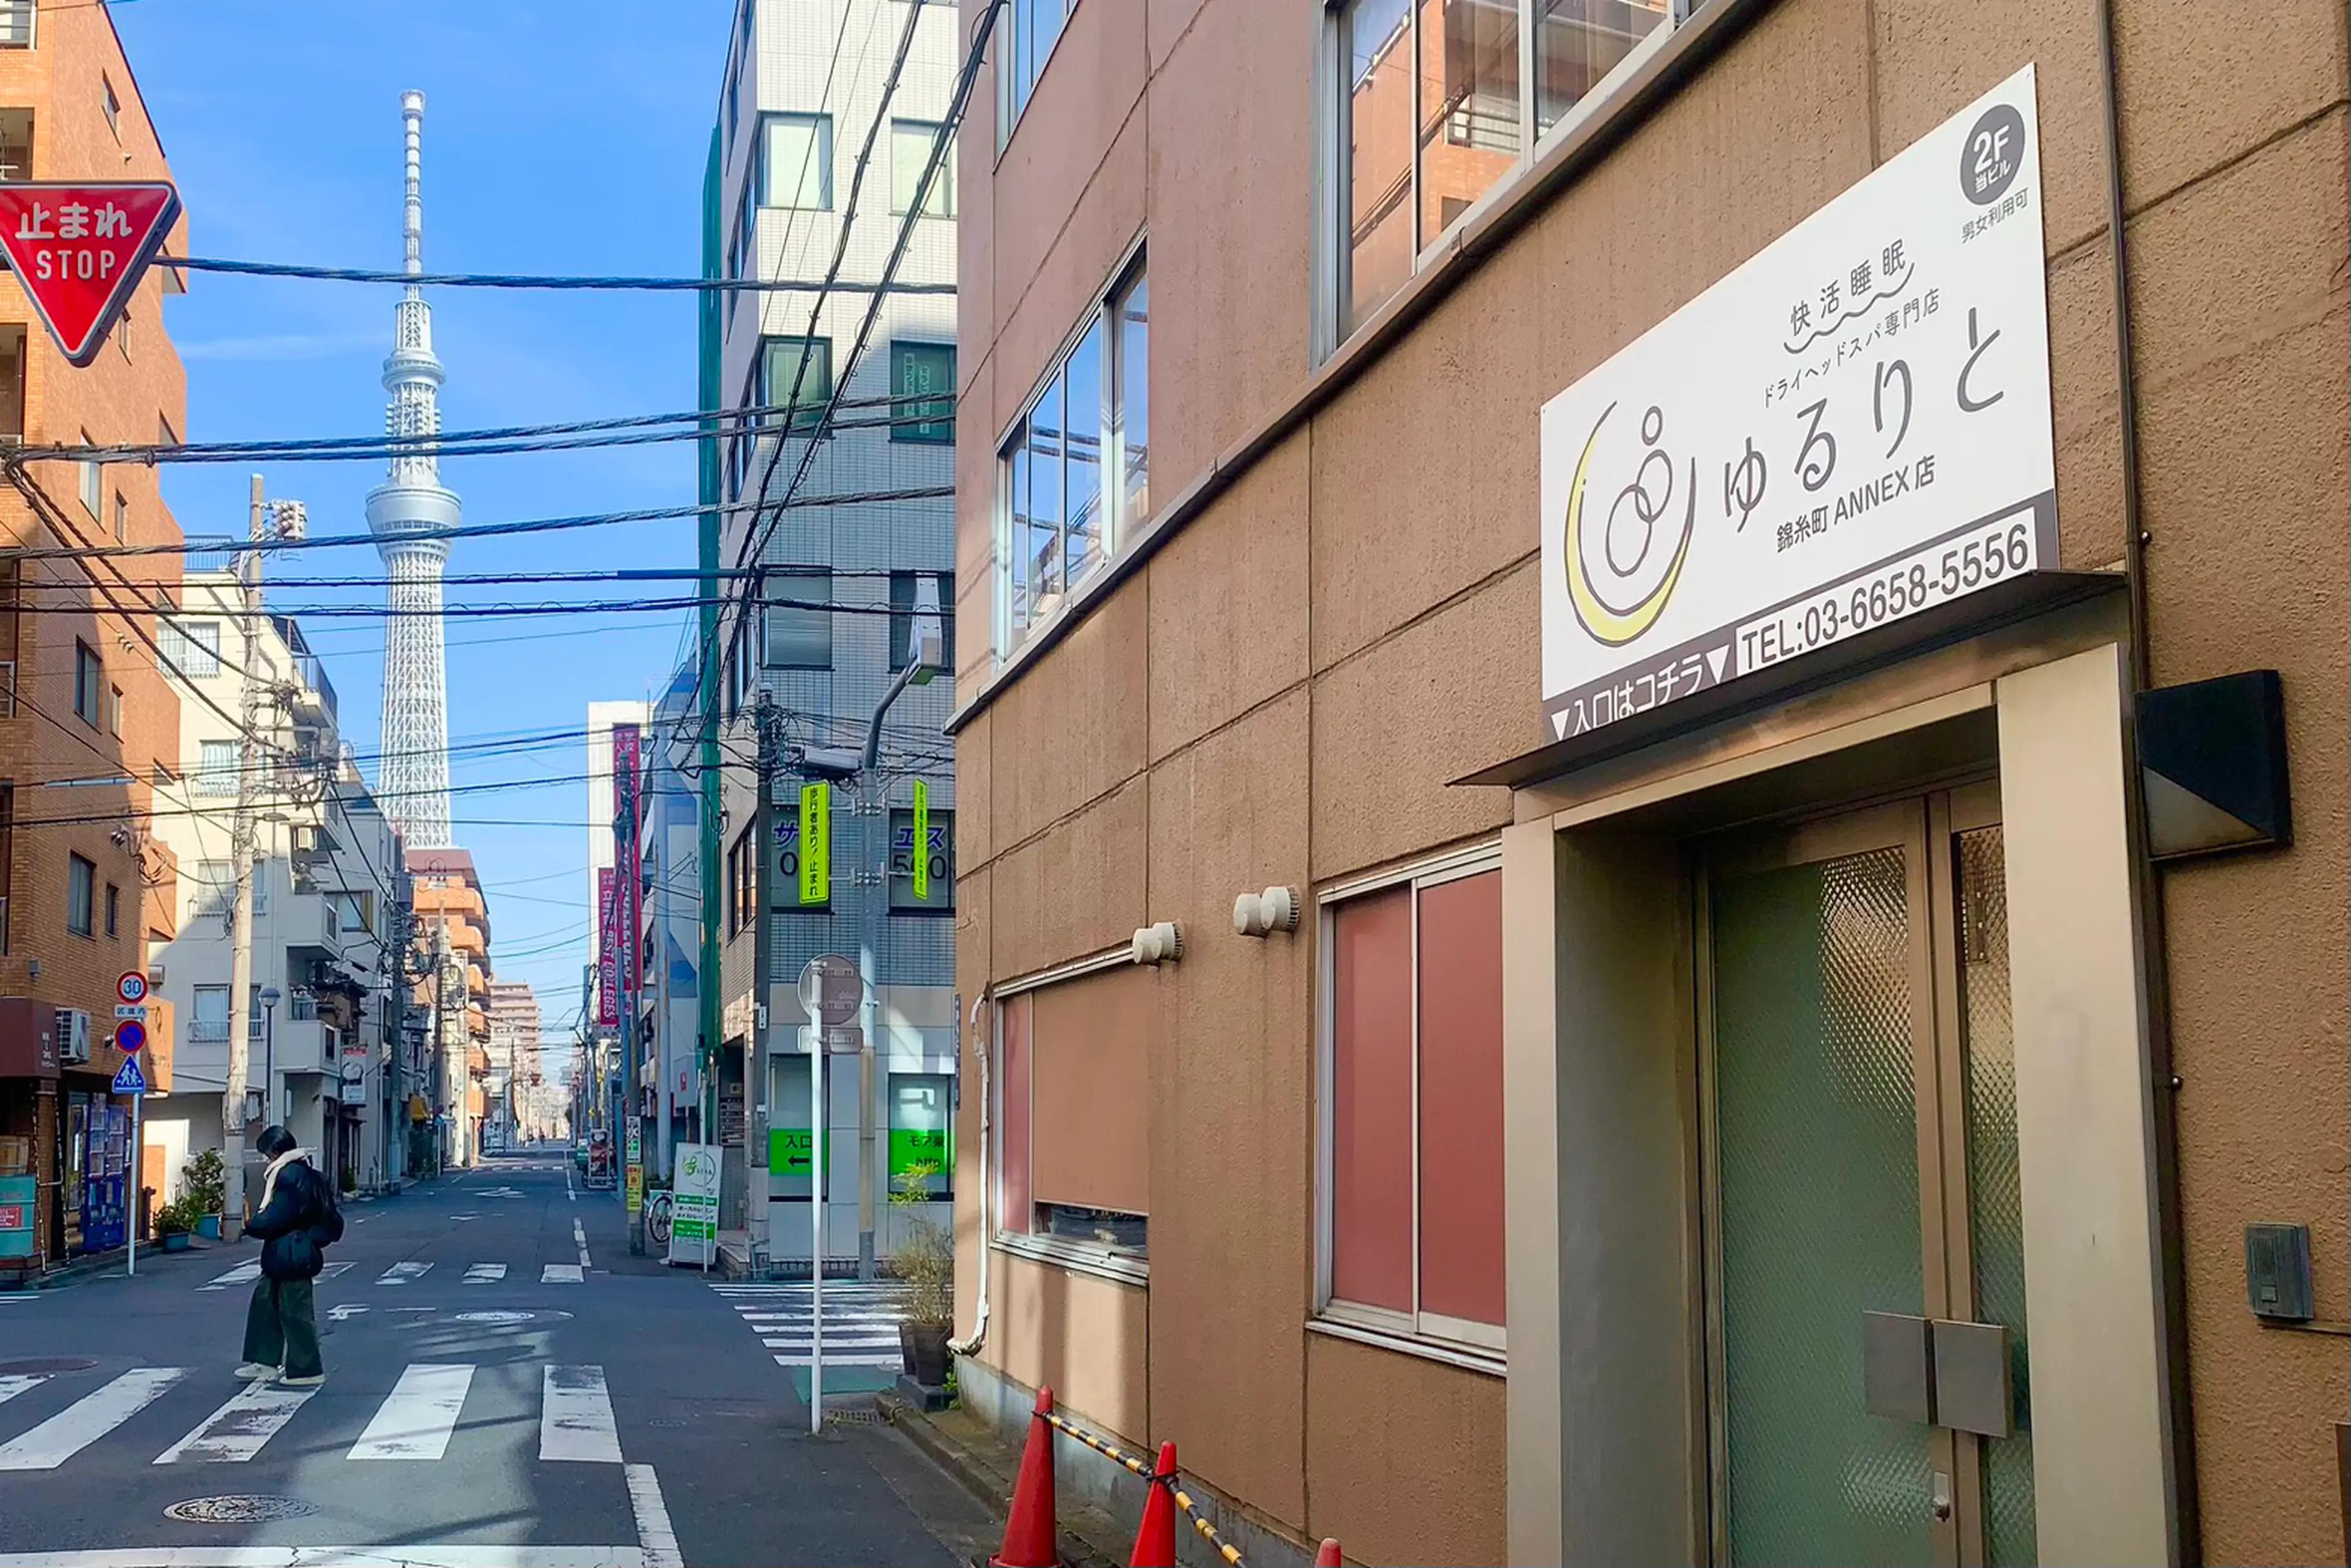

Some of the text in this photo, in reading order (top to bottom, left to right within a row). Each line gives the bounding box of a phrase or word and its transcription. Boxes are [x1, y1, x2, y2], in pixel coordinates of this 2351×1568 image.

[1974, 124, 2011, 174] 2F
[1975, 160, 2011, 193] 当ビル
[15, 201, 132, 239] 止まれ
[1962, 187, 2028, 244] 男女利用可
[36, 249, 116, 279] STOP
[1790, 238, 1906, 336] 快活睡眠
[1765, 288, 1940, 408] ドライヘッドスパ専門店
[1724, 307, 2004, 533] ゆるりと
[1777, 454, 1935, 552] 錦糸町 ANNEX 店
[1742, 523, 2028, 670] TEL:03-6658-5556
[124, 979, 141, 994] 30
[785, 1135, 812, 1149] 入口
